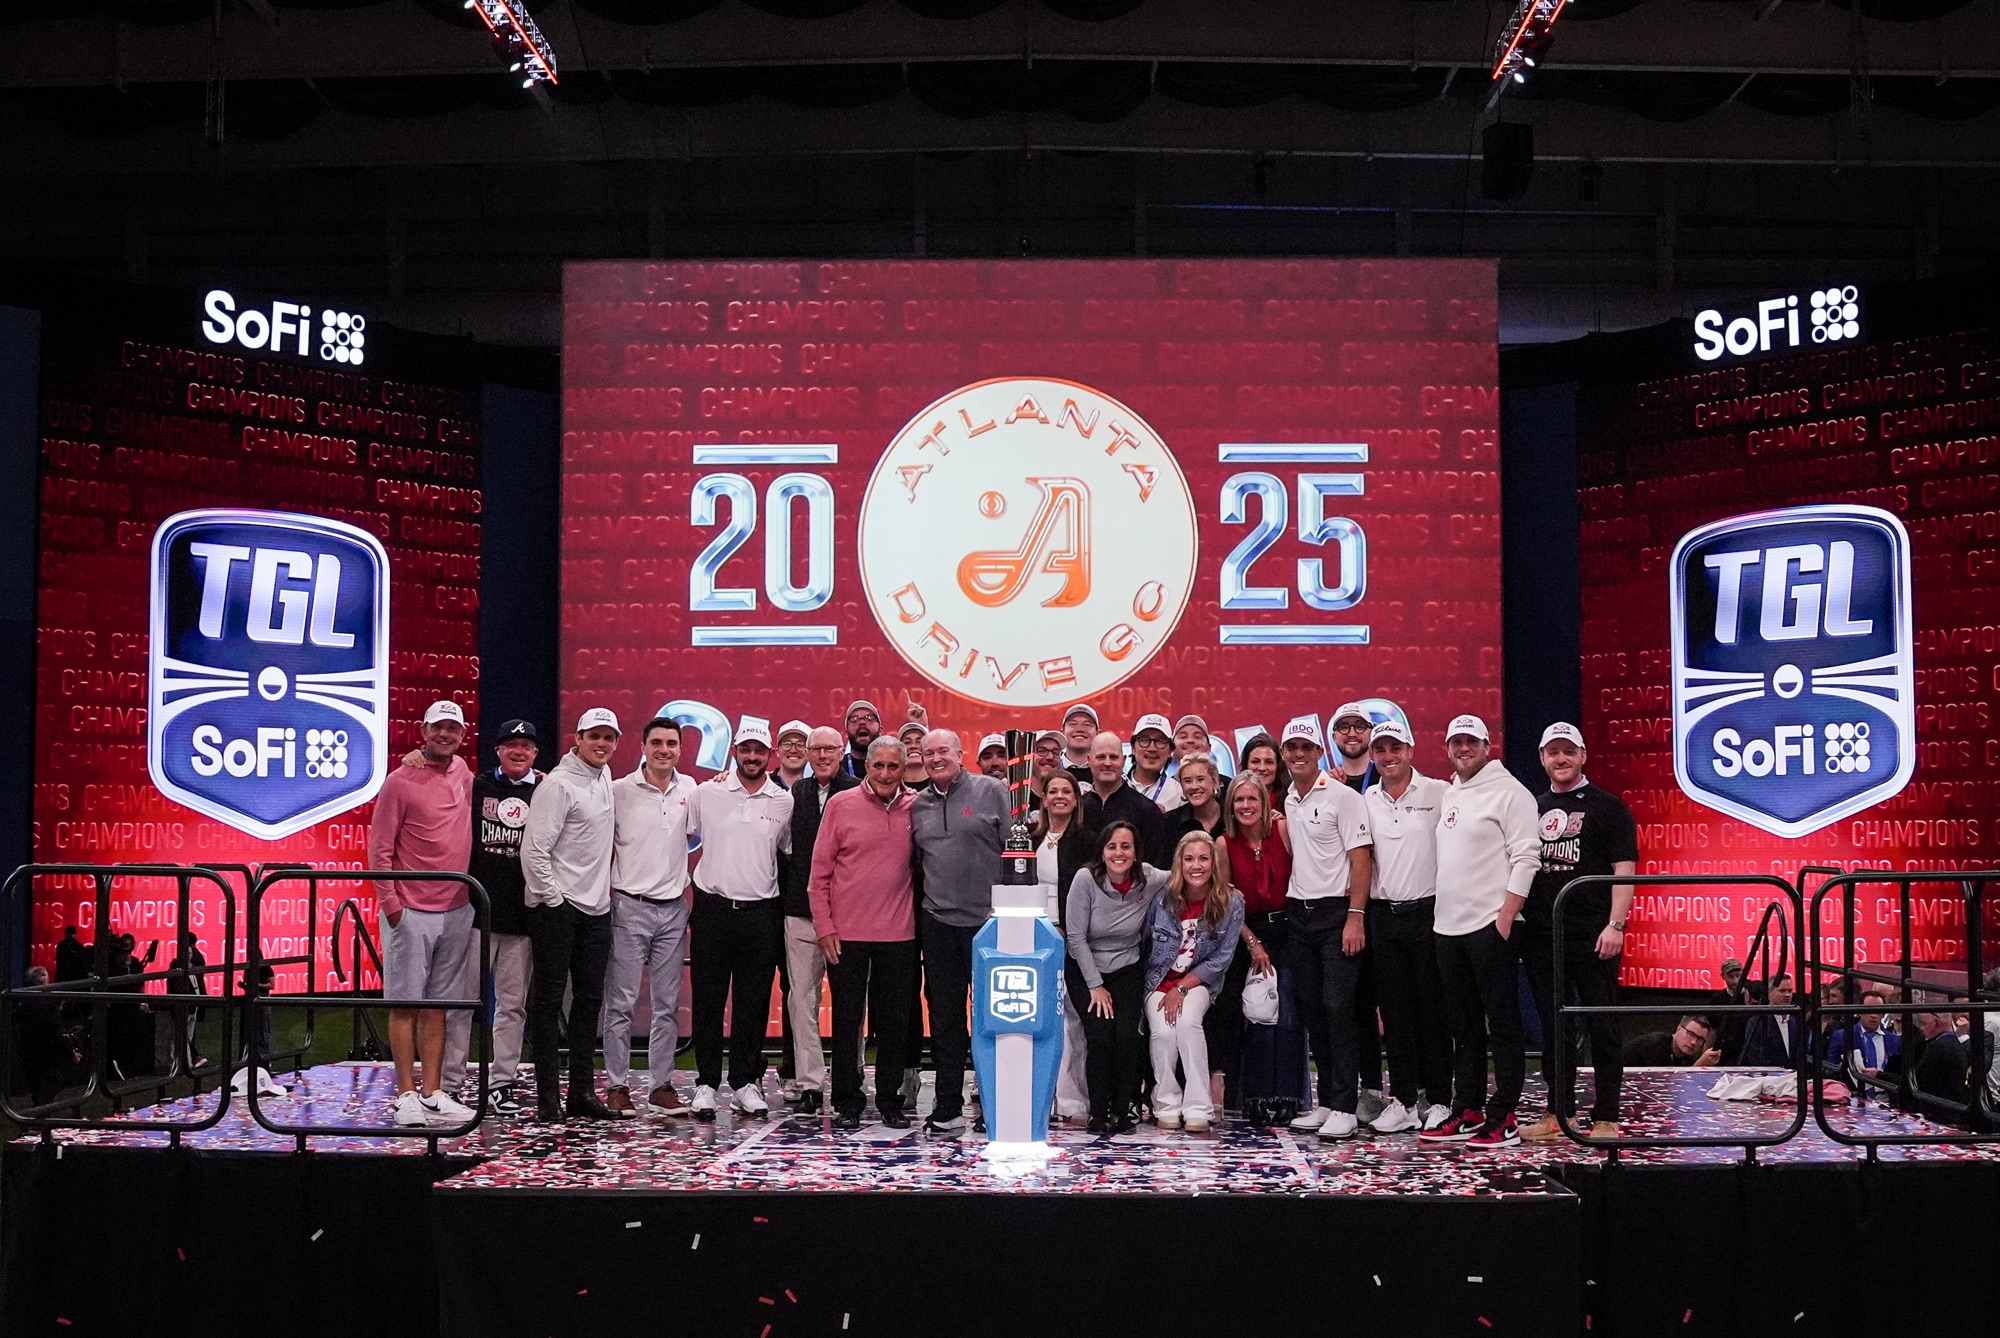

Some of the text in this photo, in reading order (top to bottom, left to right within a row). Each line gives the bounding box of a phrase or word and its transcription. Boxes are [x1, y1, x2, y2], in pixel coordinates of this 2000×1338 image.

[203, 291, 310, 355] SoFi
[727, 301, 885, 332] CHAMPIONS
[1694, 295, 1799, 360] SoFi
[122, 341, 244, 383] CHAMPIONS
[625, 344, 783, 375] CHAMPIONS
[1637, 367, 1747, 407] CHAMPIONS
[1695, 387, 1811, 428] CHAMPIONS
[1822, 367, 1947, 409] CHAMPIONS
[187, 382, 306, 423] CHAMPIONS
[317, 401, 427, 439] CHAMPIONS
[242, 425, 358, 464] CHAMPIONS
[368, 442, 475, 479] CHAMPIONS
[895, 393, 1161, 503] ATLANTA
[1747, 415, 1868, 456] CHAMPIONS
[376, 478, 482, 513] CHAMPIONS
[690, 472, 835, 612] 20
[1219, 471, 1367, 610] 25
[191, 542, 355, 648] TGL
[1704, 540, 1873, 645] TGL
[887, 581, 1078, 692] DRIVE
[742, 728, 767, 737] APOLLO
[1292, 724, 1314, 734] BDO
[191, 724, 297, 778] SoFi
[1712, 723, 1815, 778] SoFi
[55, 822, 184, 850] CHAMPIONS
[481, 819, 523, 846] CHAMPI
[1852, 819, 1980, 848] CHAMPIONS
[78, 901, 206, 930] CAMPIOS
[218, 899, 336, 927] CHMPIONS
[1625, 932, 1735, 960] CHAMPIONS
[996, 971, 1032, 991] TGL
[997, 1002, 1019, 1013] SoFi
